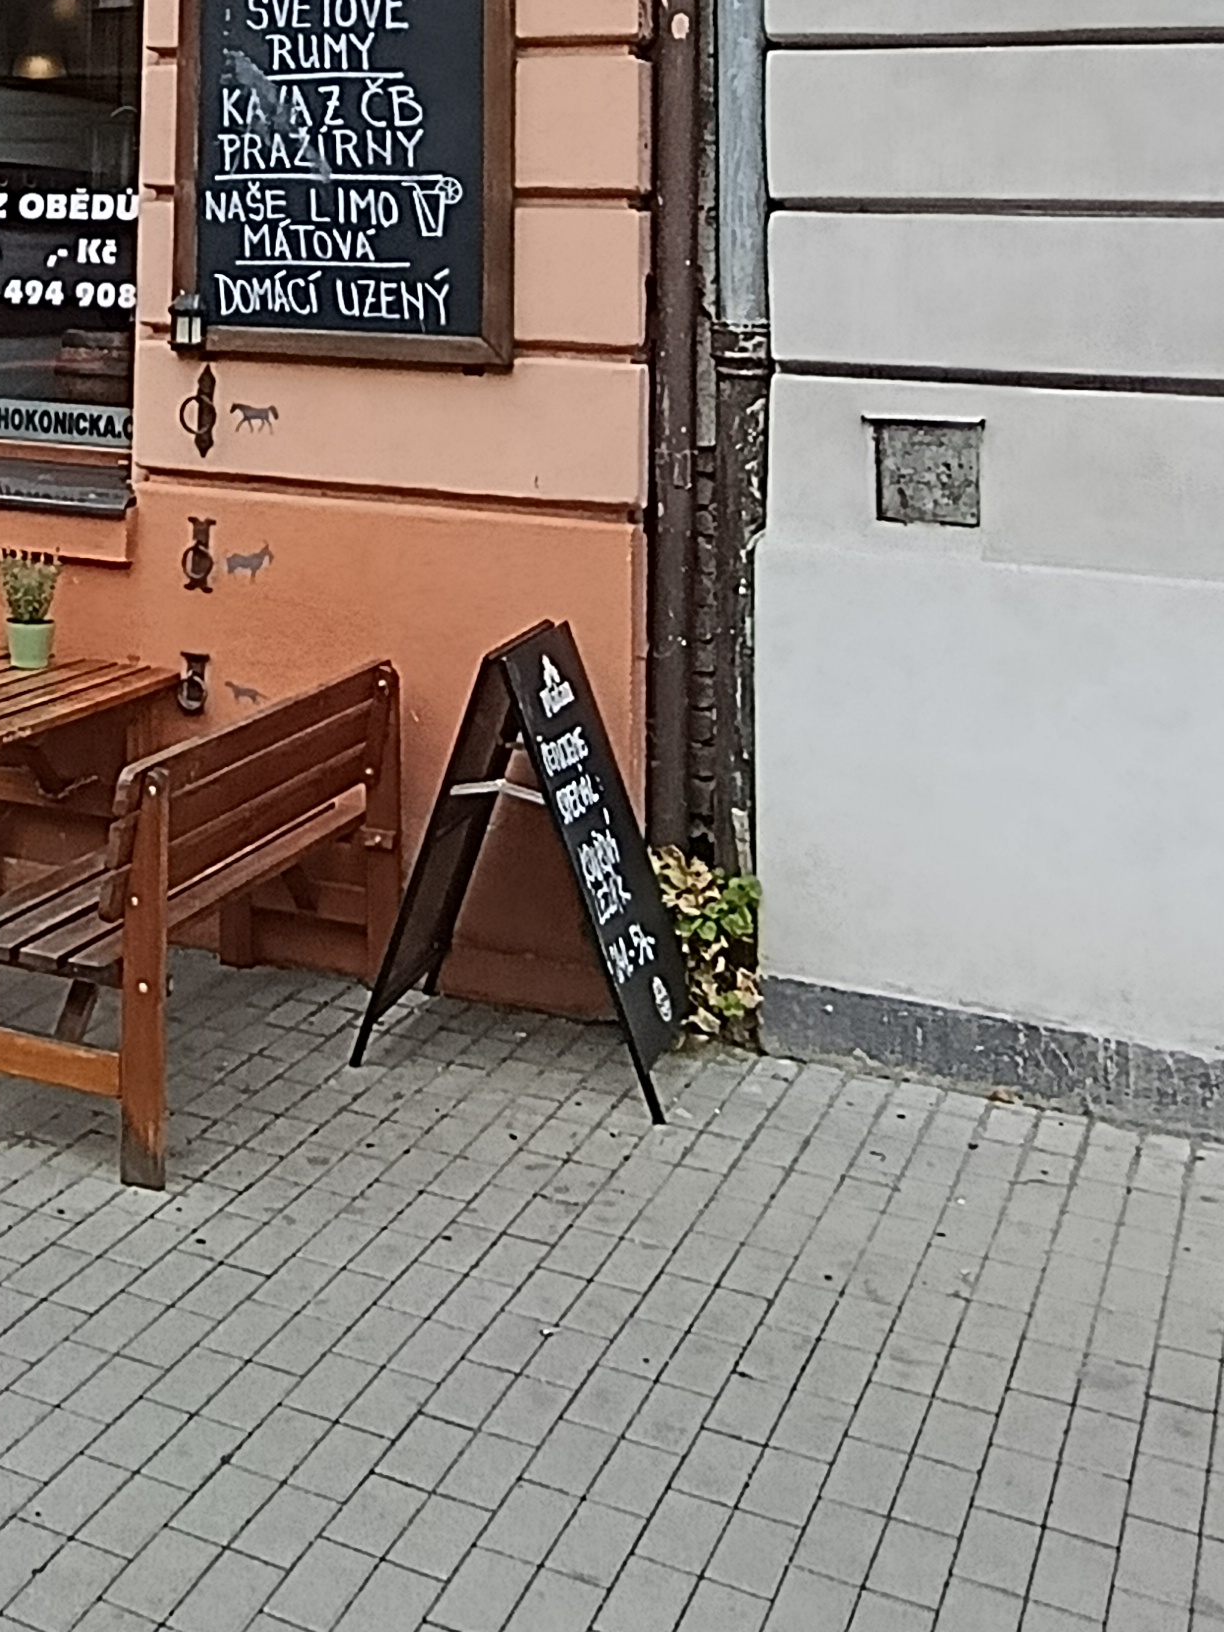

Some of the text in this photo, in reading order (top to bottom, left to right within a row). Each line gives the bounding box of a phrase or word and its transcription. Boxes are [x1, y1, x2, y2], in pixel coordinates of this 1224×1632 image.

[265, 31, 375, 71] RUMY
[317, 85, 346, 126] Z
[360, 78, 424, 128] ČB
[217, 125, 425, 172] PRAŽÍRNY
[18, 187, 139, 221] OBĚDŮ
[205, 181, 399, 228] NAŠE LIMO
[76, 238, 118, 265] Kč
[243, 218, 376, 261] MÁTOVÁ
[3, 278, 65, 306] 494
[75, 282, 137, 309] 908
[214, 267, 450, 325] DOMÁCÍ UZENÝ
